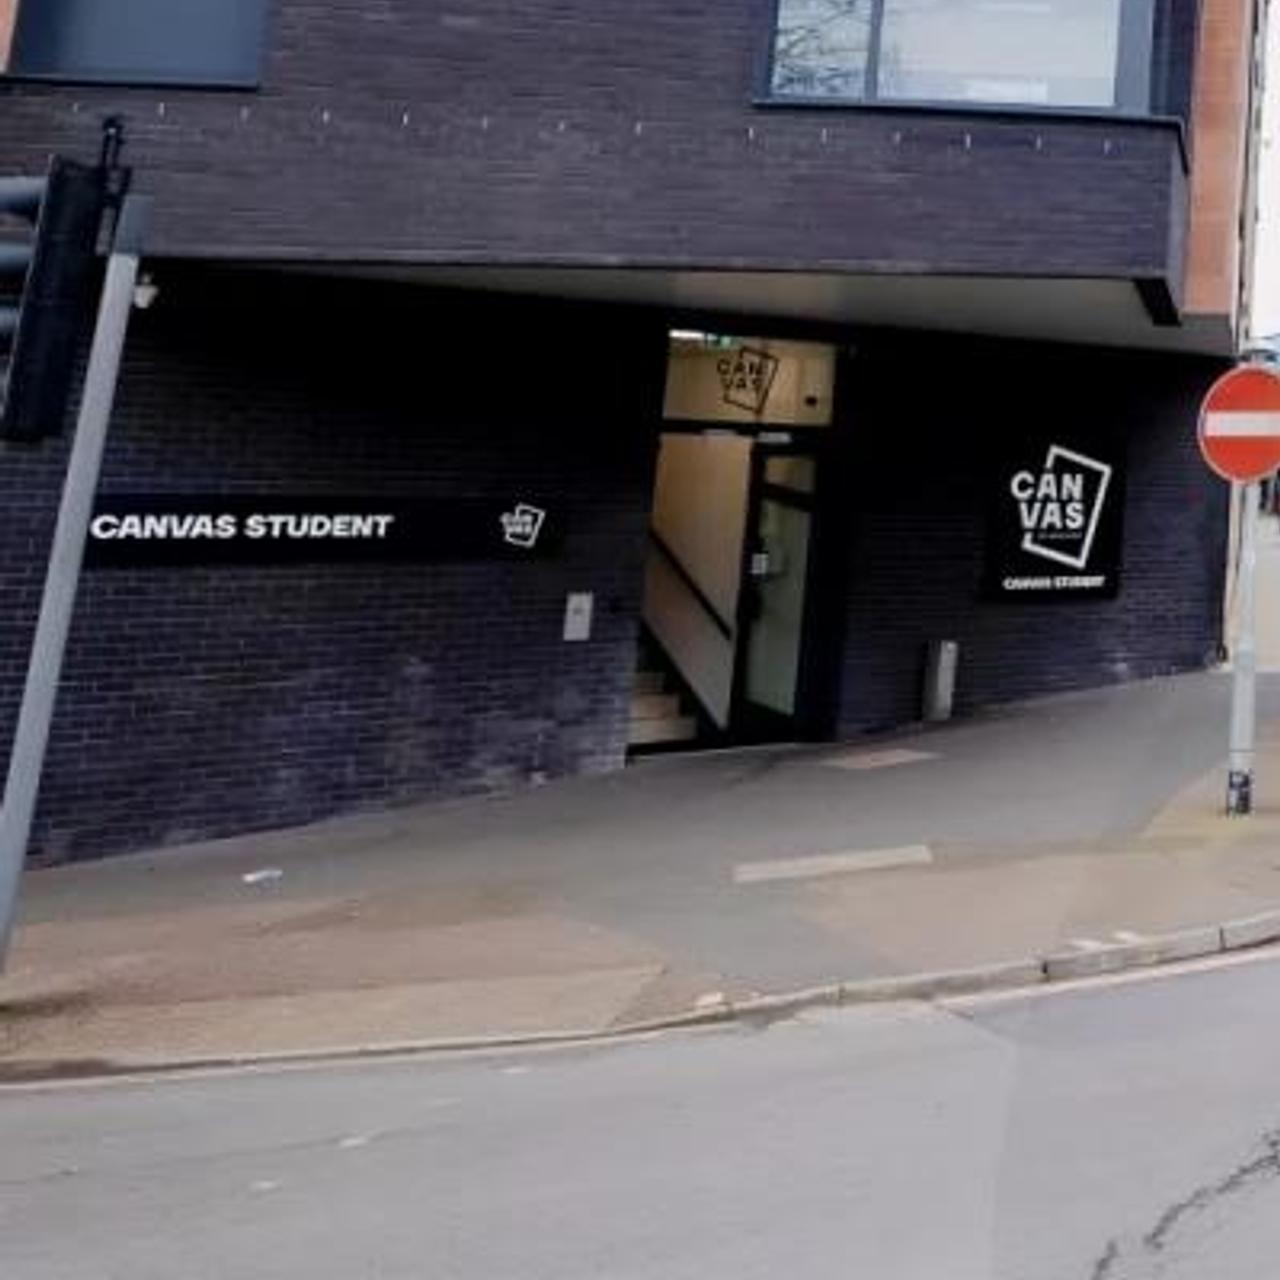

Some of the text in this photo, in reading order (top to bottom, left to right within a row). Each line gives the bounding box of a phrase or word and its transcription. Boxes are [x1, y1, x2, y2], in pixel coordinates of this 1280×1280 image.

[1011, 471, 1083, 501] CAN
[89, 513, 394, 539] CANVAS STUDENT
[1020, 502, 1085, 530] VAS
